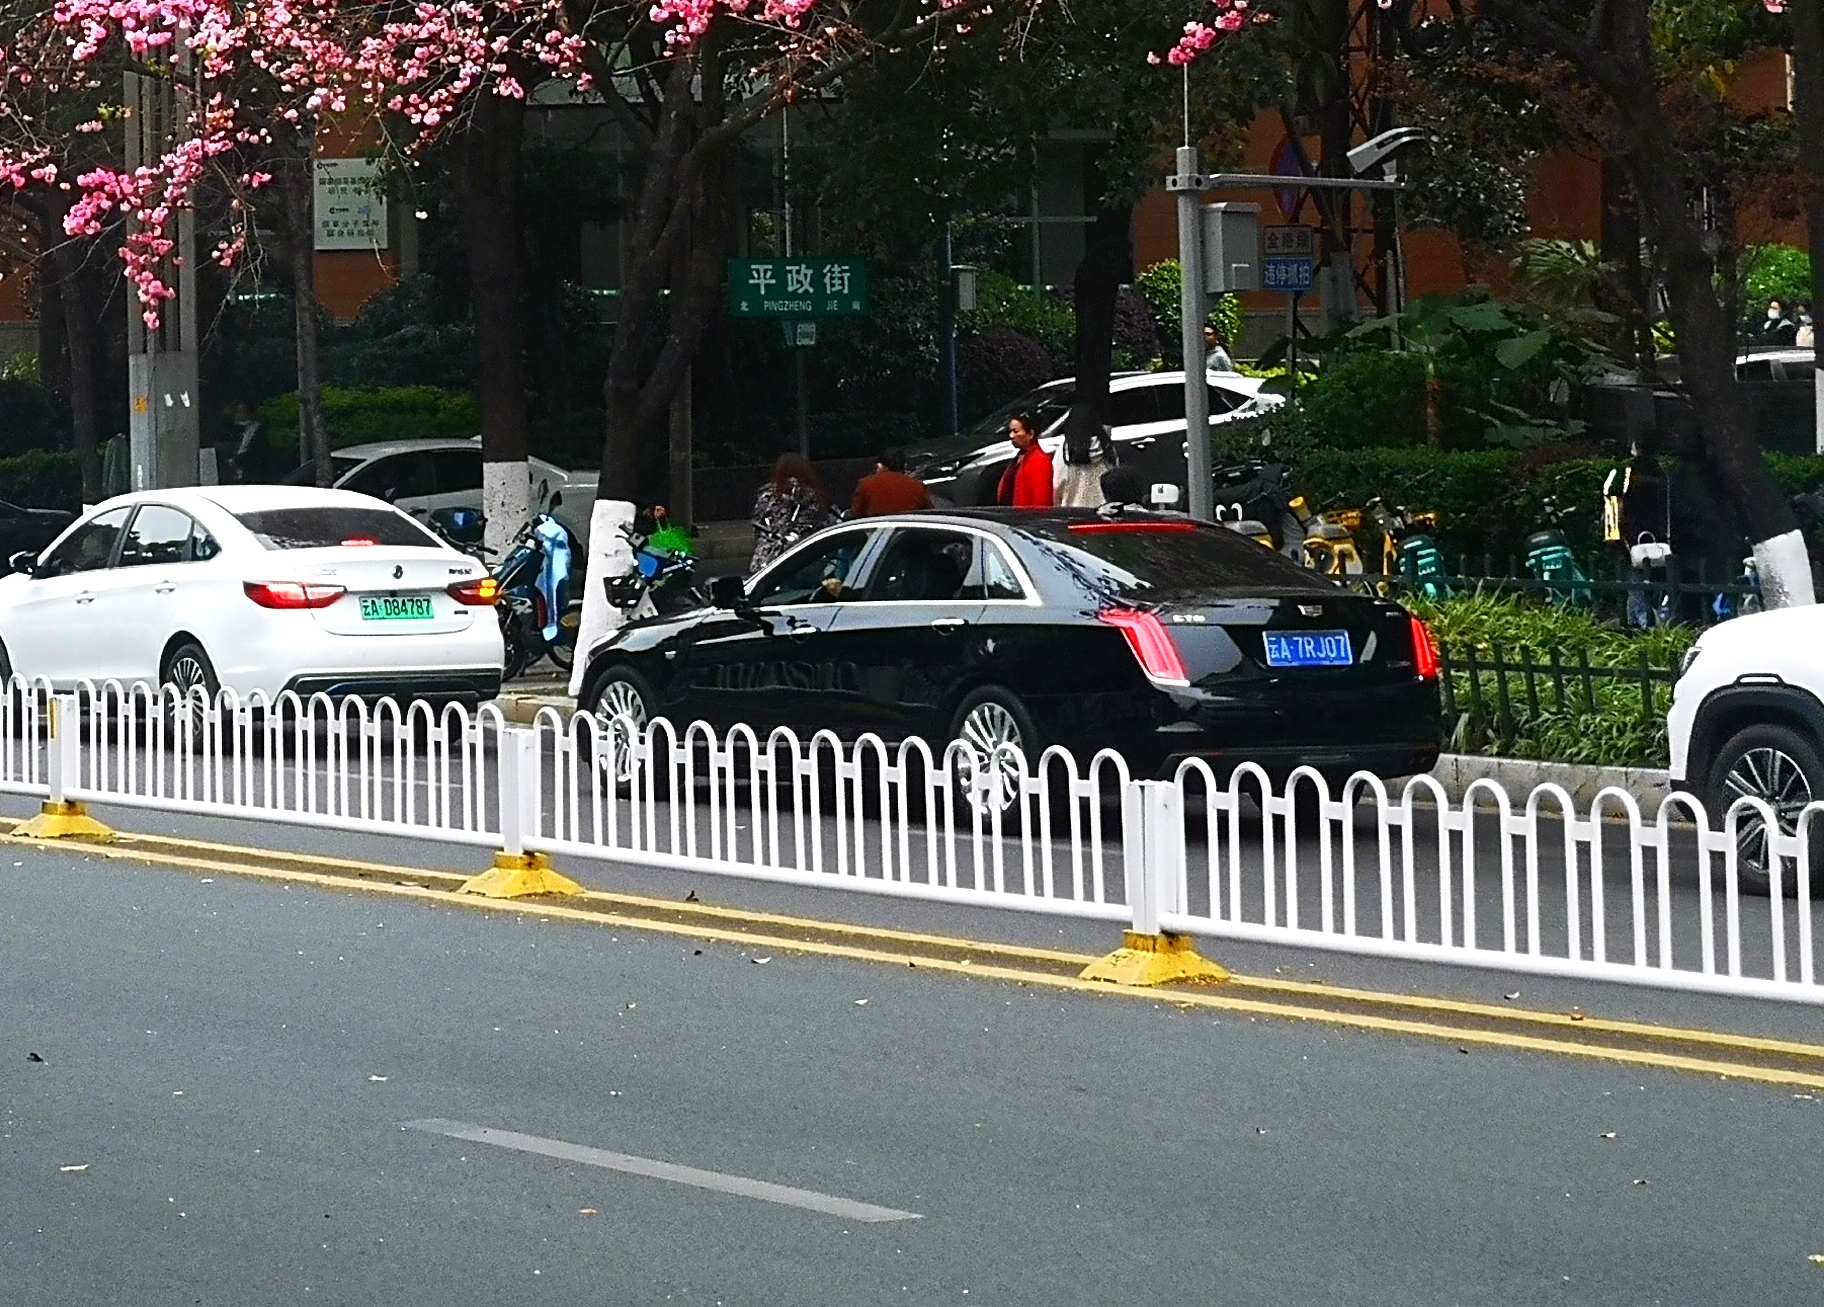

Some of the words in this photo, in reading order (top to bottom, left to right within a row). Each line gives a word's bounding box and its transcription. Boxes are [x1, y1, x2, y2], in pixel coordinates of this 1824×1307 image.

[748, 263, 851, 295] 平政街
[764, 300, 812, 311] PINGZHENG
[826, 300, 839, 311] JIE
